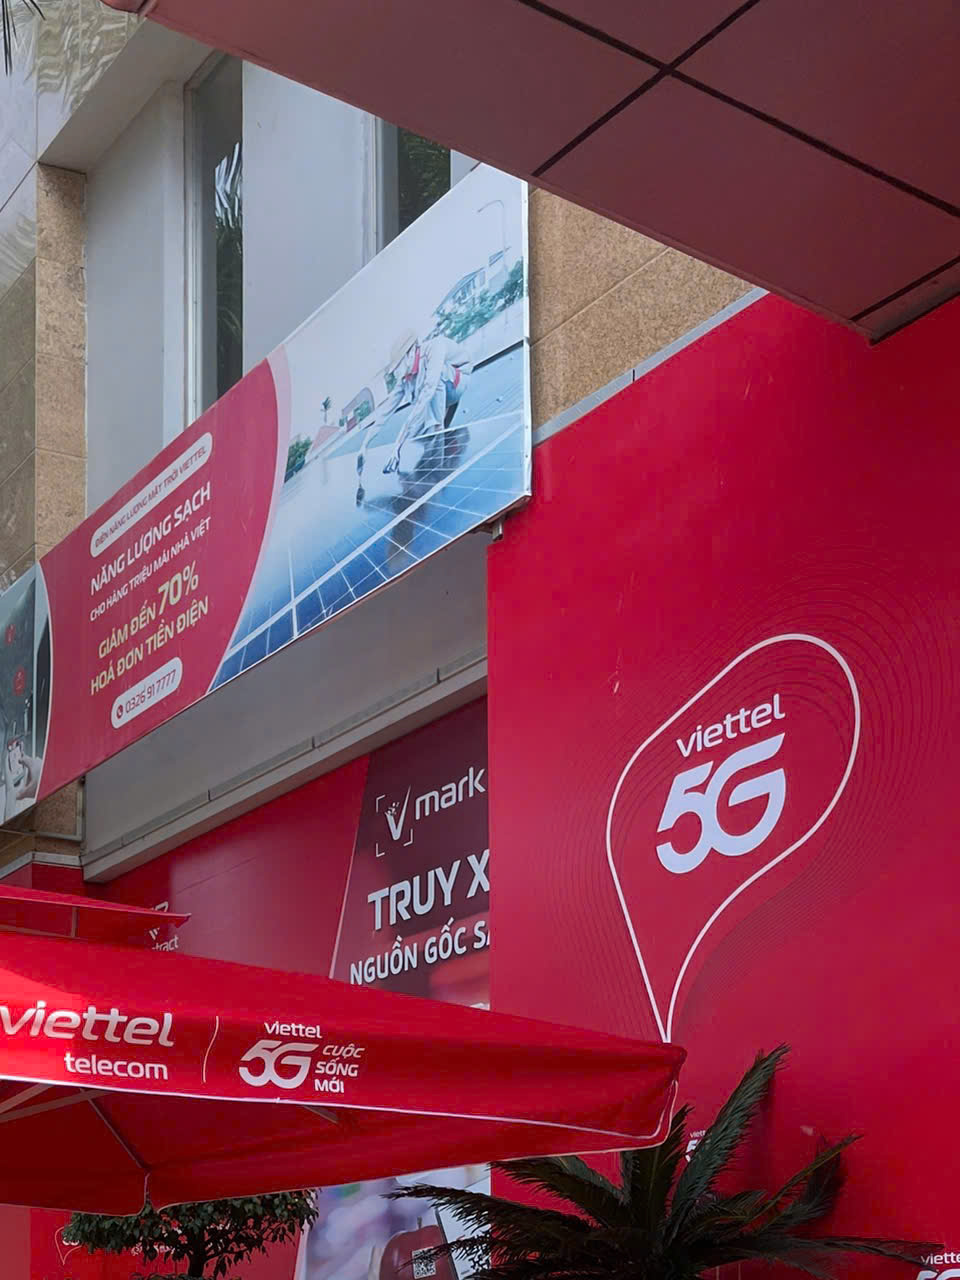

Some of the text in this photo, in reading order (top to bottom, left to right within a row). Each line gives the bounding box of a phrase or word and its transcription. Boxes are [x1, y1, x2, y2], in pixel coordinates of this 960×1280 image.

[89, 602, 106, 621] CHO
[106, 583, 129, 610] HÀNG
[128, 563, 153, 592] TRIỆU
[190, 516, 212, 541] VIỆT
[91, 480, 211, 596] NĂNG LƯỢNG SẠCH
[98, 560, 199, 659] GIẢM ĐẾN 70%
[90, 595, 209, 696] HOÁ ĐƠN TIỀN ĐIỆN
[675, 692, 786, 758] viettel
[415, 766, 487, 820] mark
[655, 732, 787, 874] 5G
[367, 859, 461, 932] TRUY
[349, 934, 418, 986] NGUỒN
[424, 916, 467, 966] GỐC
[264, 1020, 323, 1039] viettel
[322, 1043, 366, 1059] CUỘC
[63, 1051, 169, 1081] telecom
[238, 1039, 320, 1090] 5G
[314, 1077, 345, 1094] MỚI
[315, 1057, 359, 1078] SỐNG
